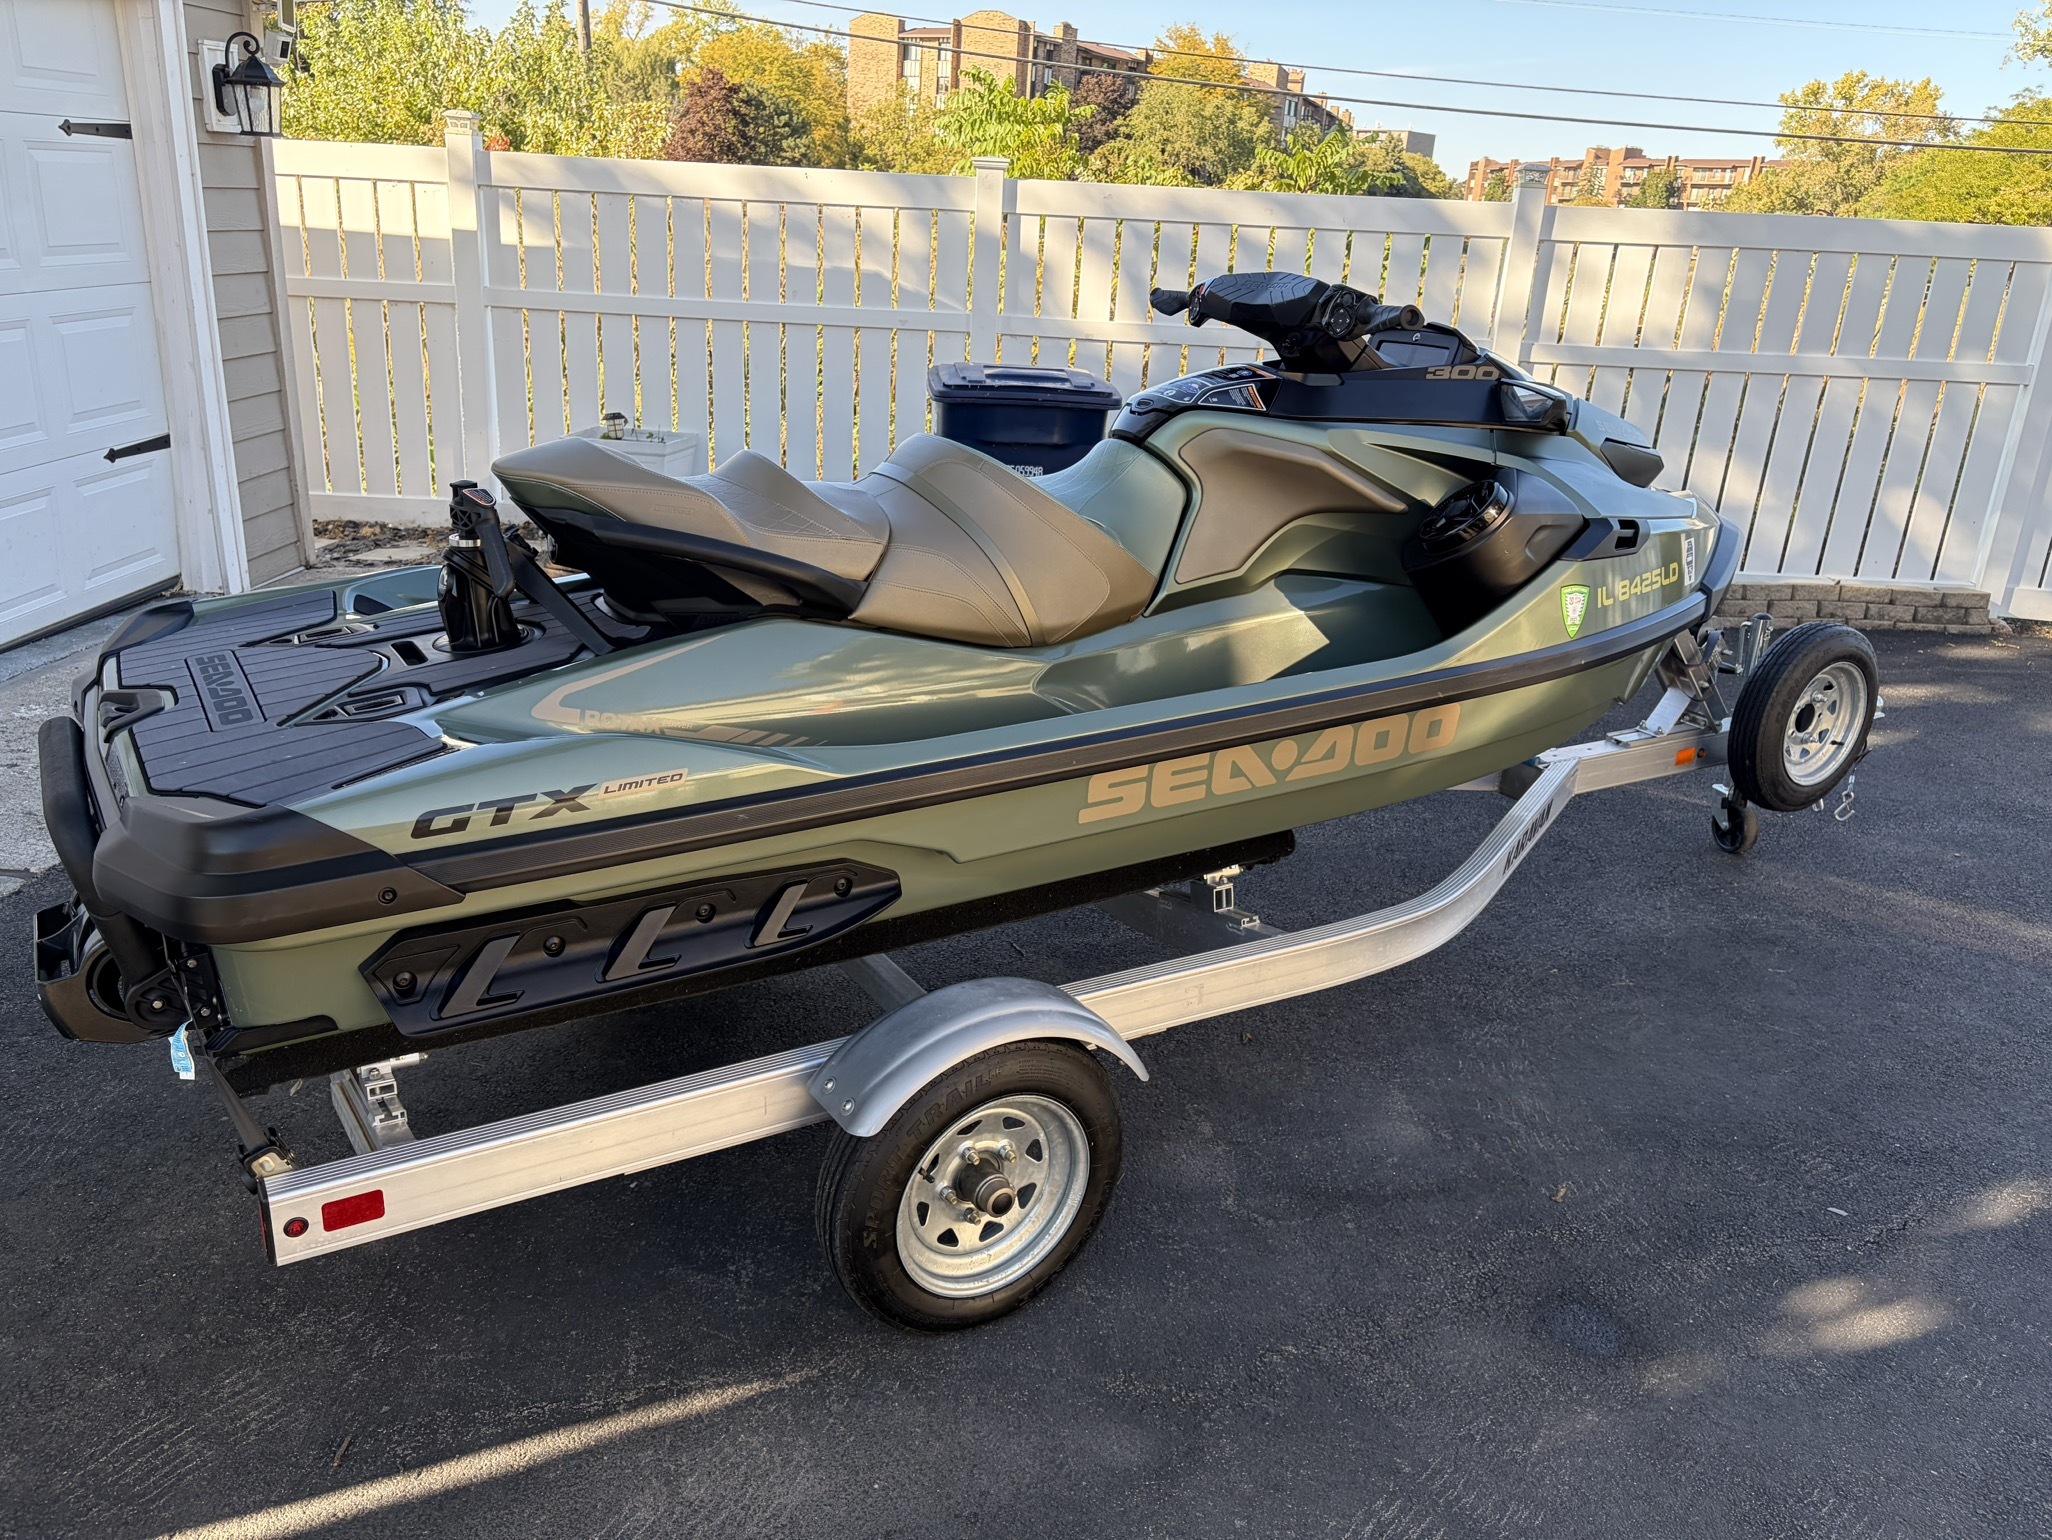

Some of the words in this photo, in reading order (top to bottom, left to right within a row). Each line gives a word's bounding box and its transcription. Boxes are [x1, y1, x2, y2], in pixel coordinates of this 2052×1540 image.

[1425, 365, 1500, 380] 300
[1597, 586, 1614, 609] IL
[1618, 562, 1679, 602] 8425LD
[410, 783, 598, 840] GTX
[604, 772, 684, 795] LIMITED
[1502, 798, 1554, 876] KARAVAN
[863, 1143, 907, 1249] SPORT
[905, 1075, 992, 1141] TRAIL
